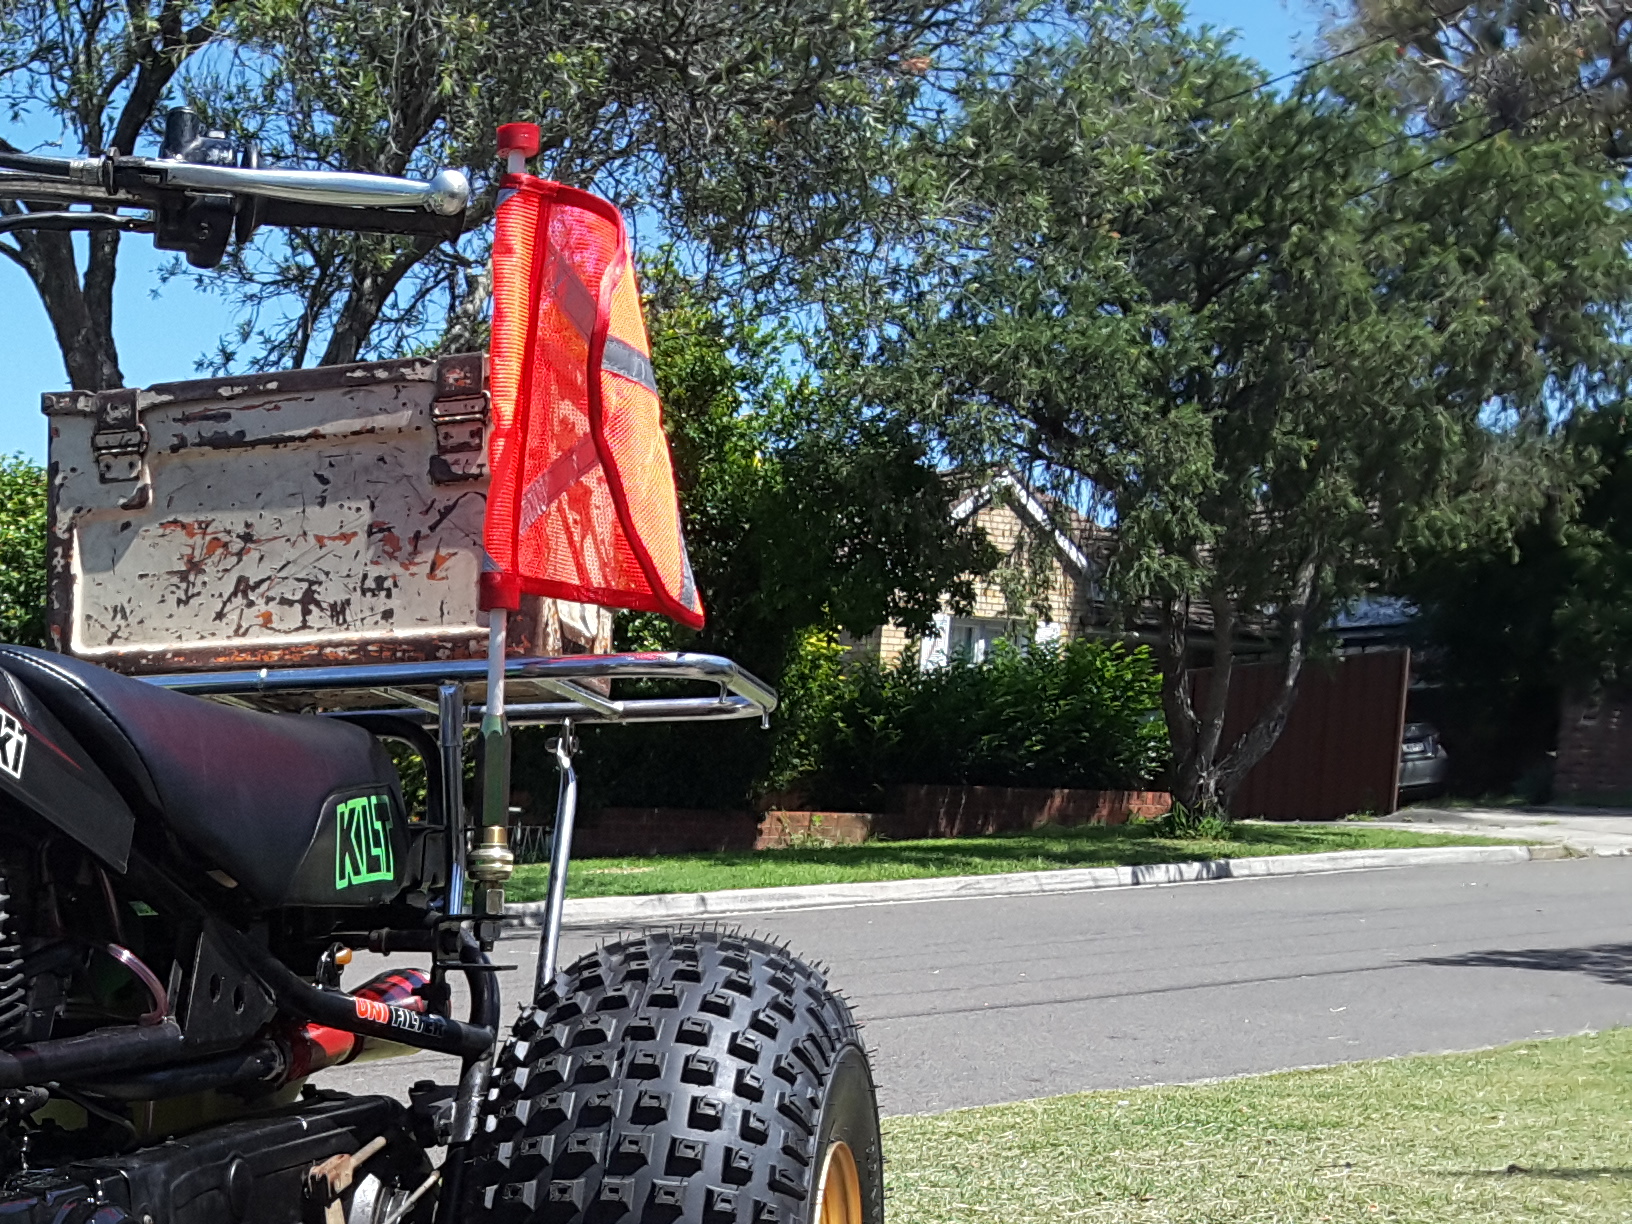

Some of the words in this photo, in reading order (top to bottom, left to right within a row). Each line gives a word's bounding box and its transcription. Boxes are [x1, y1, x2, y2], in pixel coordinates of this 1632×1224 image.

[335, 795, 394, 890] KLT
[355, 996, 389, 1025] UNI
[390, 1005, 446, 1038] FILTER
